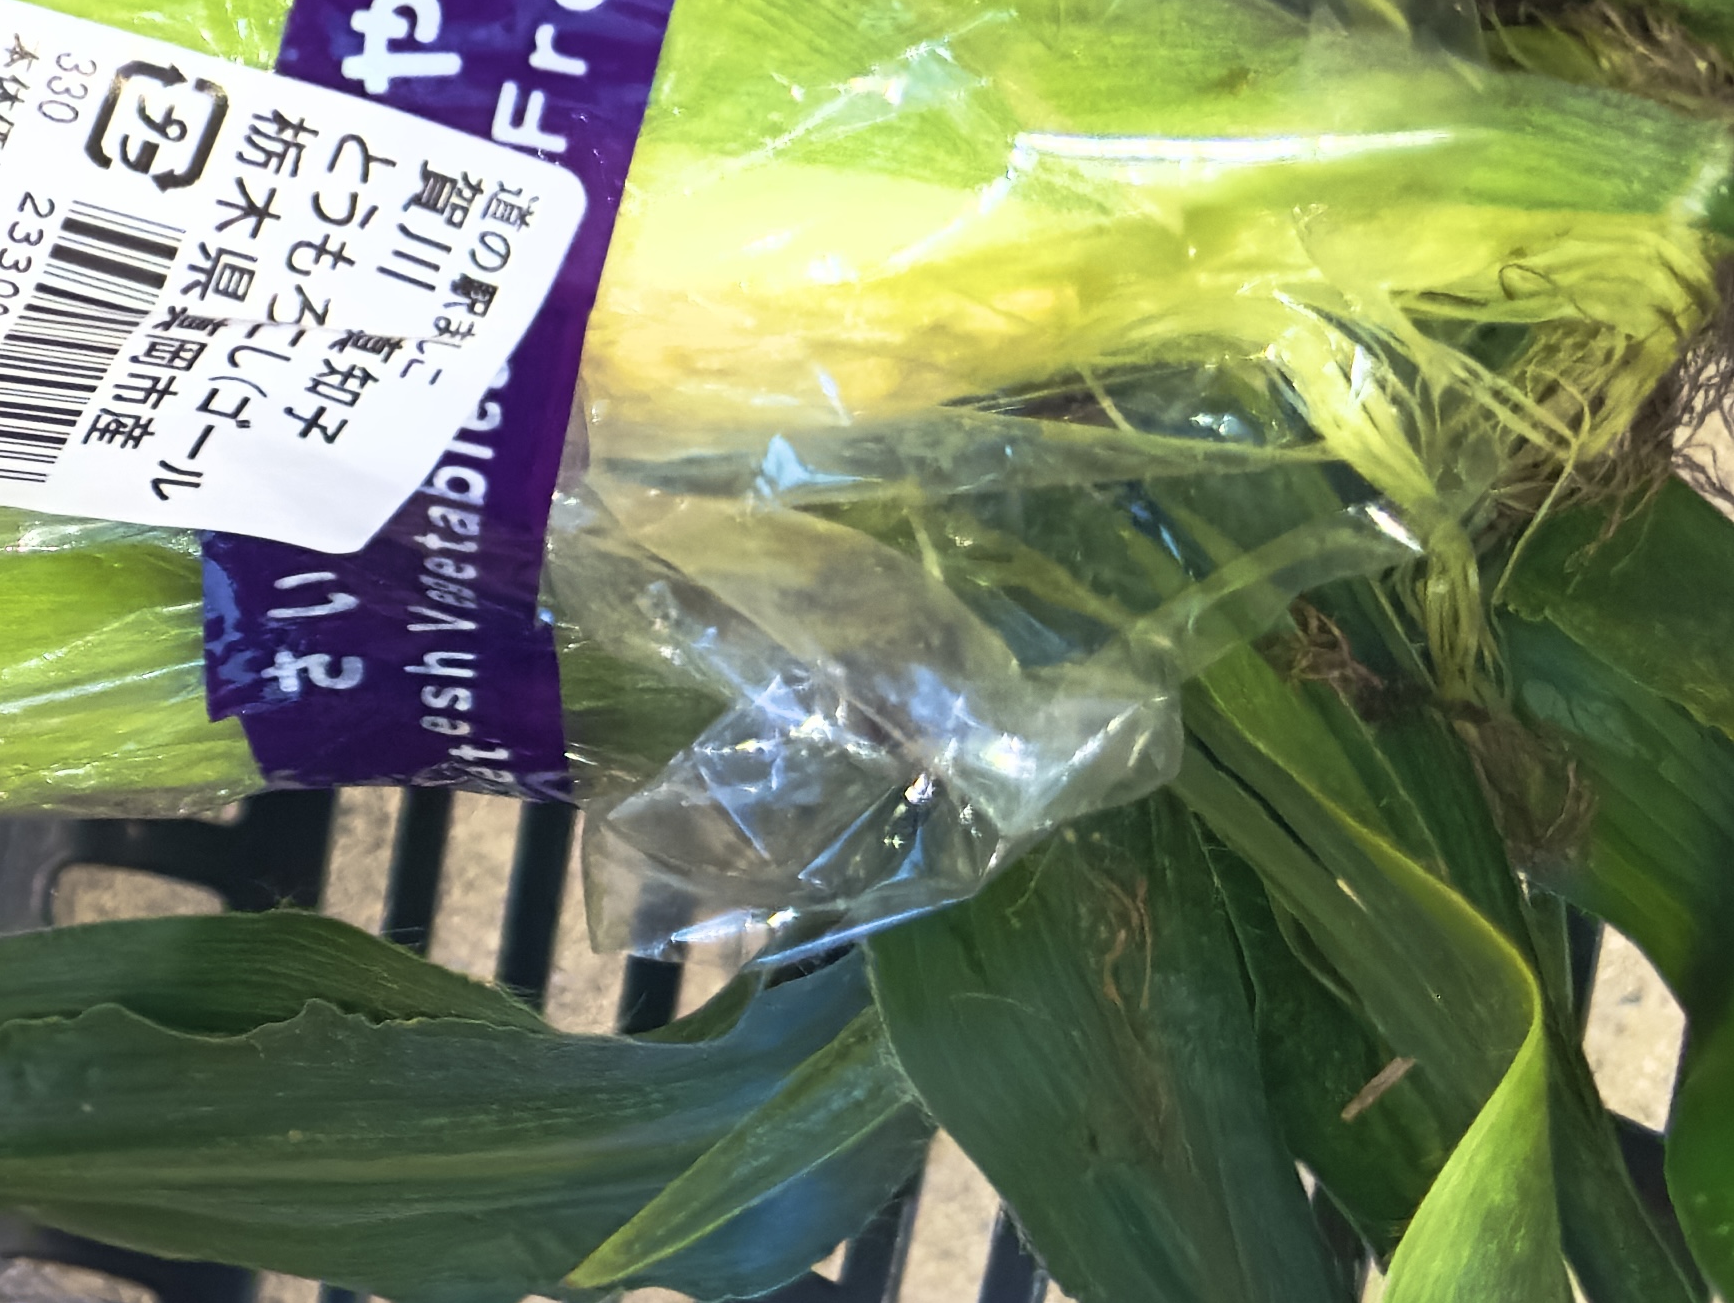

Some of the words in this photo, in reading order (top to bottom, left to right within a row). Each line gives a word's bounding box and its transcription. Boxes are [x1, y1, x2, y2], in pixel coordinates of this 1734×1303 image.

[36, 51, 98, 125] 330
[80, 108, 317, 451] 栃木県真岡市産
[375, 158, 484, 293] 賀川
[285, 328, 406, 446] 真知子
